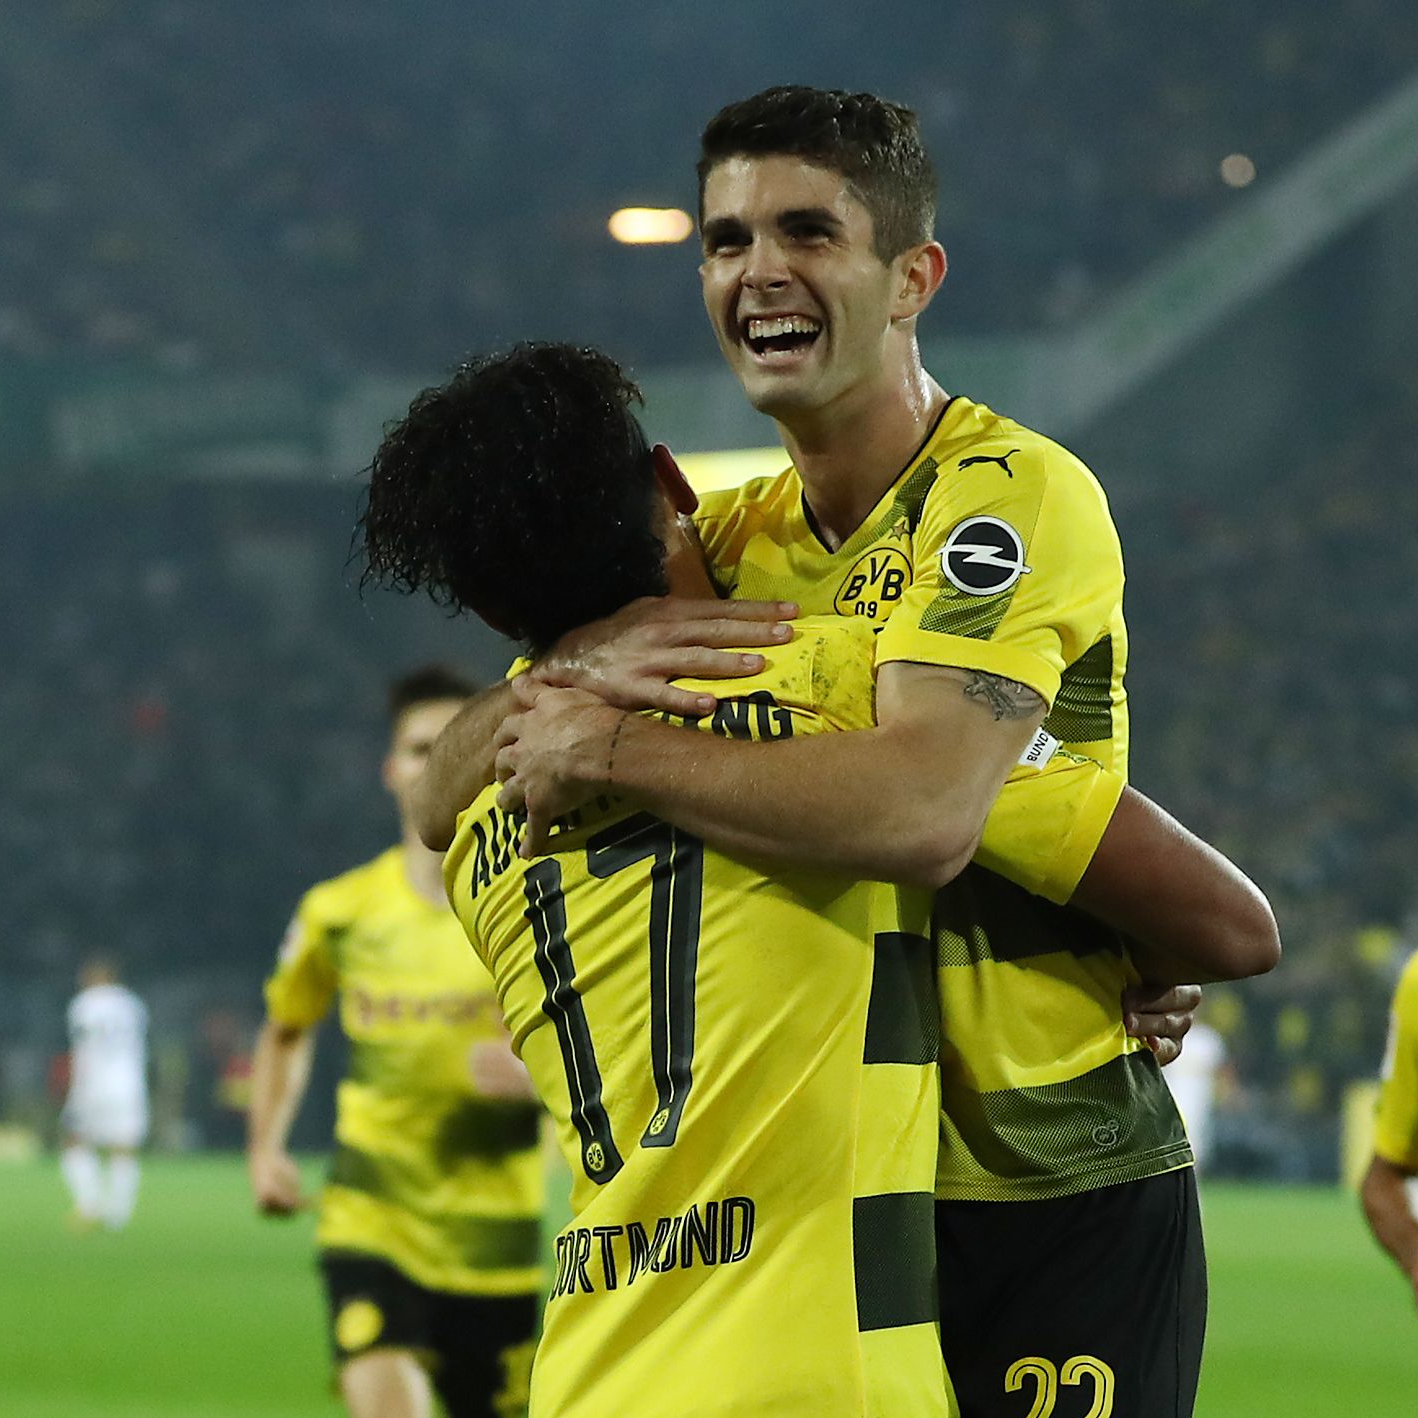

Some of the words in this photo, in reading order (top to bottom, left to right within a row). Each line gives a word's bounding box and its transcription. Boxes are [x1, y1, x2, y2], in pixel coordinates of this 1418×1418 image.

[842, 554, 905, 601] BVB
[1026, 732, 1049, 762] BUND
[523, 810, 704, 1186] 17
